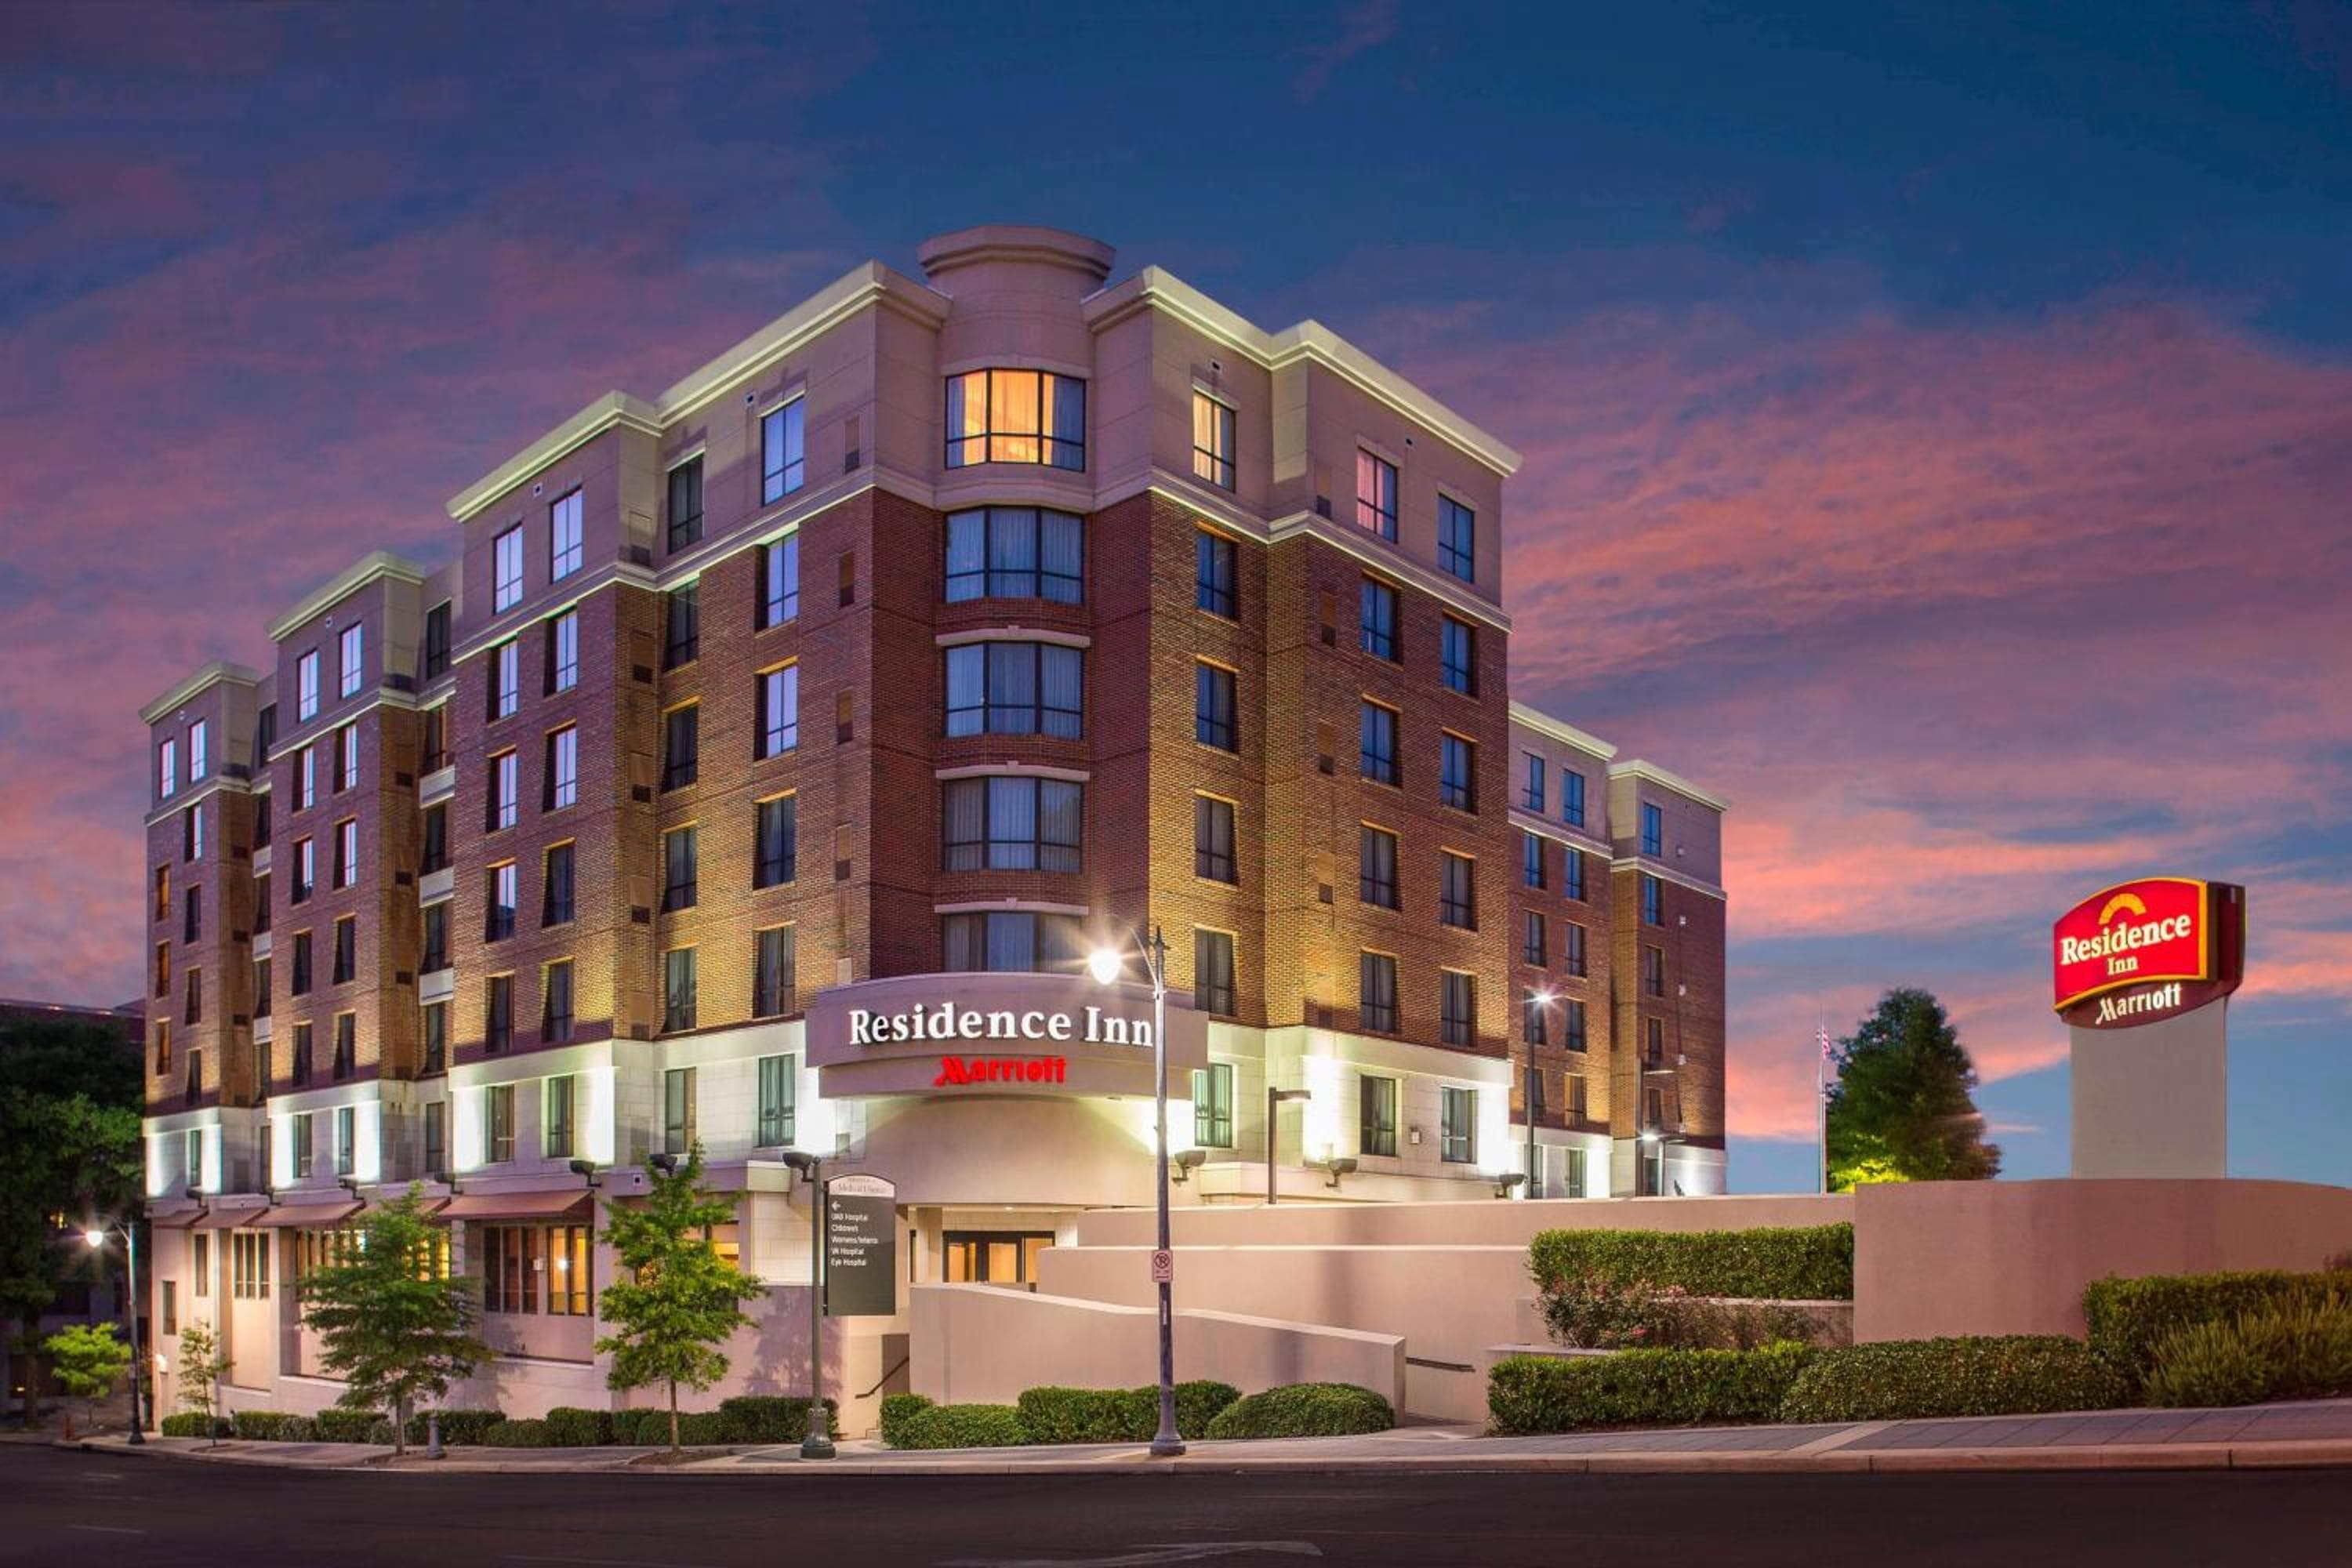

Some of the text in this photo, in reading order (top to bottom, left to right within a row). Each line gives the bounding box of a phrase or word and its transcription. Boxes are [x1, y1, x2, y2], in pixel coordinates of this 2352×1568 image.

[2060, 915, 2191, 965] Residence
[2107, 956, 2139, 975] Inn
[2096, 982, 2182, 1024] Marriott
[849, 1002, 1153, 1047] Residence Inn
[934, 1055, 1066, 1087] Marriott
[843, 1258, 866, 1267] Hospital
